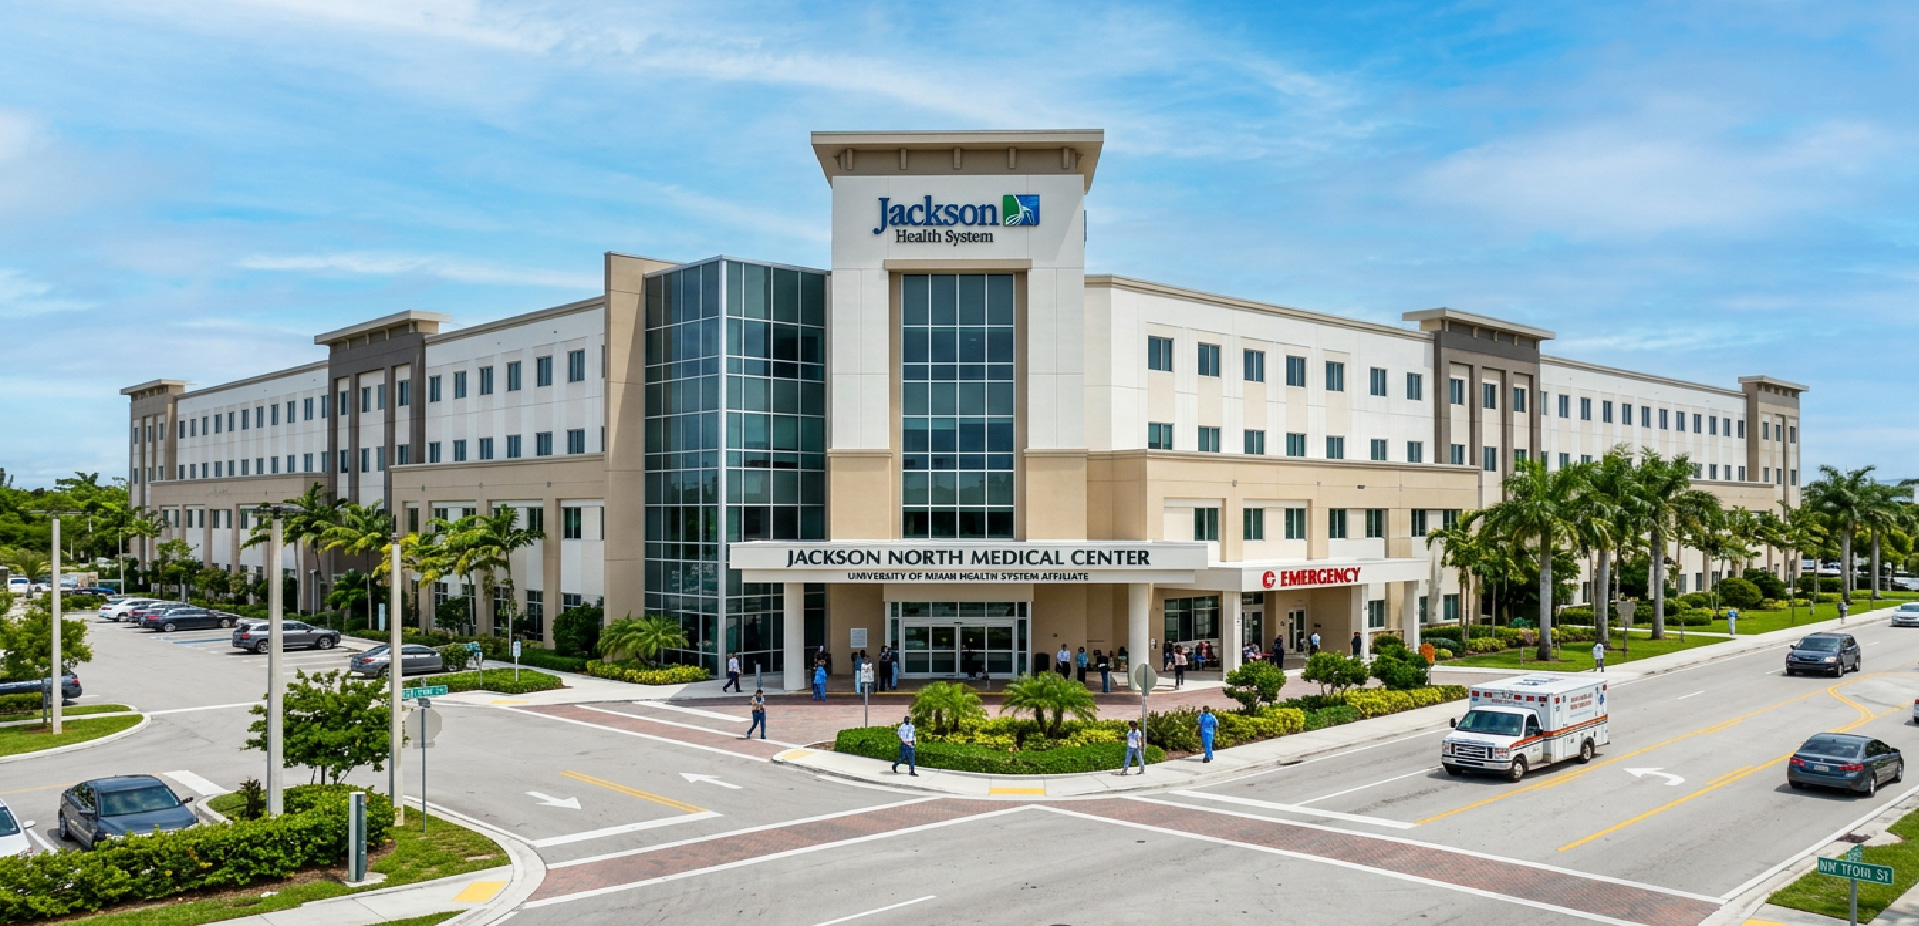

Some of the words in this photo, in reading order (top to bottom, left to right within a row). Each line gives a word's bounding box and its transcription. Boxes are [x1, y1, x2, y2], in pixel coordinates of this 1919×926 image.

[872, 195, 1000, 234] Jackson
[895, 229, 942, 243] Health
[945, 229, 994, 246] System
[786, 550, 881, 567] JACKSON
[888, 550, 963, 565] NORTH
[970, 550, 1064, 565] MEDICAL
[1071, 550, 1151, 565] CENTER
[908, 572, 923, 580] OF
[1280, 567, 1361, 587] EMERGENCY
